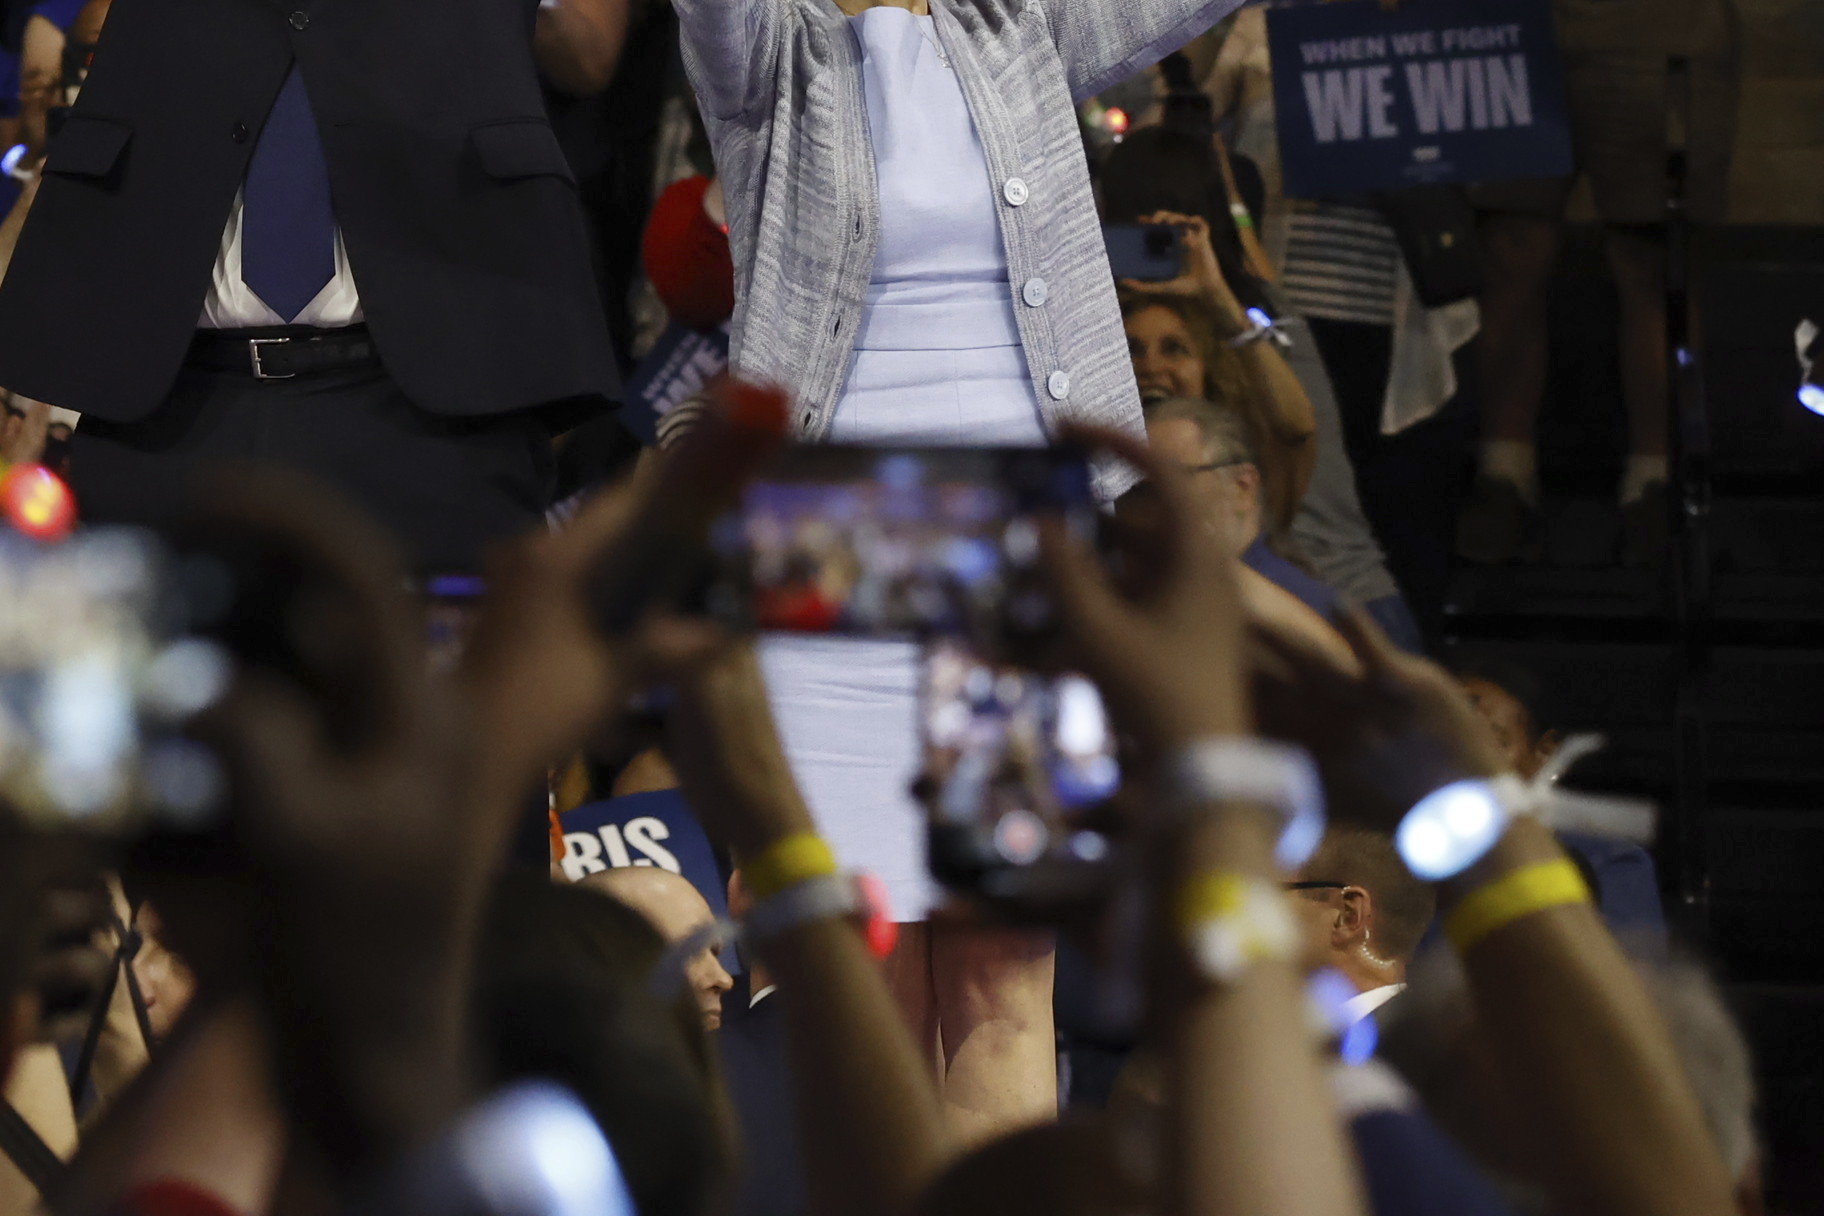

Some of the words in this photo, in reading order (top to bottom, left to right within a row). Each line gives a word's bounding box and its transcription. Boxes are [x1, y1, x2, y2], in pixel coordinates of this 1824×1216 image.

[1298, 34, 1388, 65] WHEN
[1390, 30, 1437, 57] WE
[1440, 22, 1522, 53] FIGHT
[1301, 64, 1399, 143] WE
[1403, 52, 1534, 135] WIN
[560, 815, 682, 883] RIS
